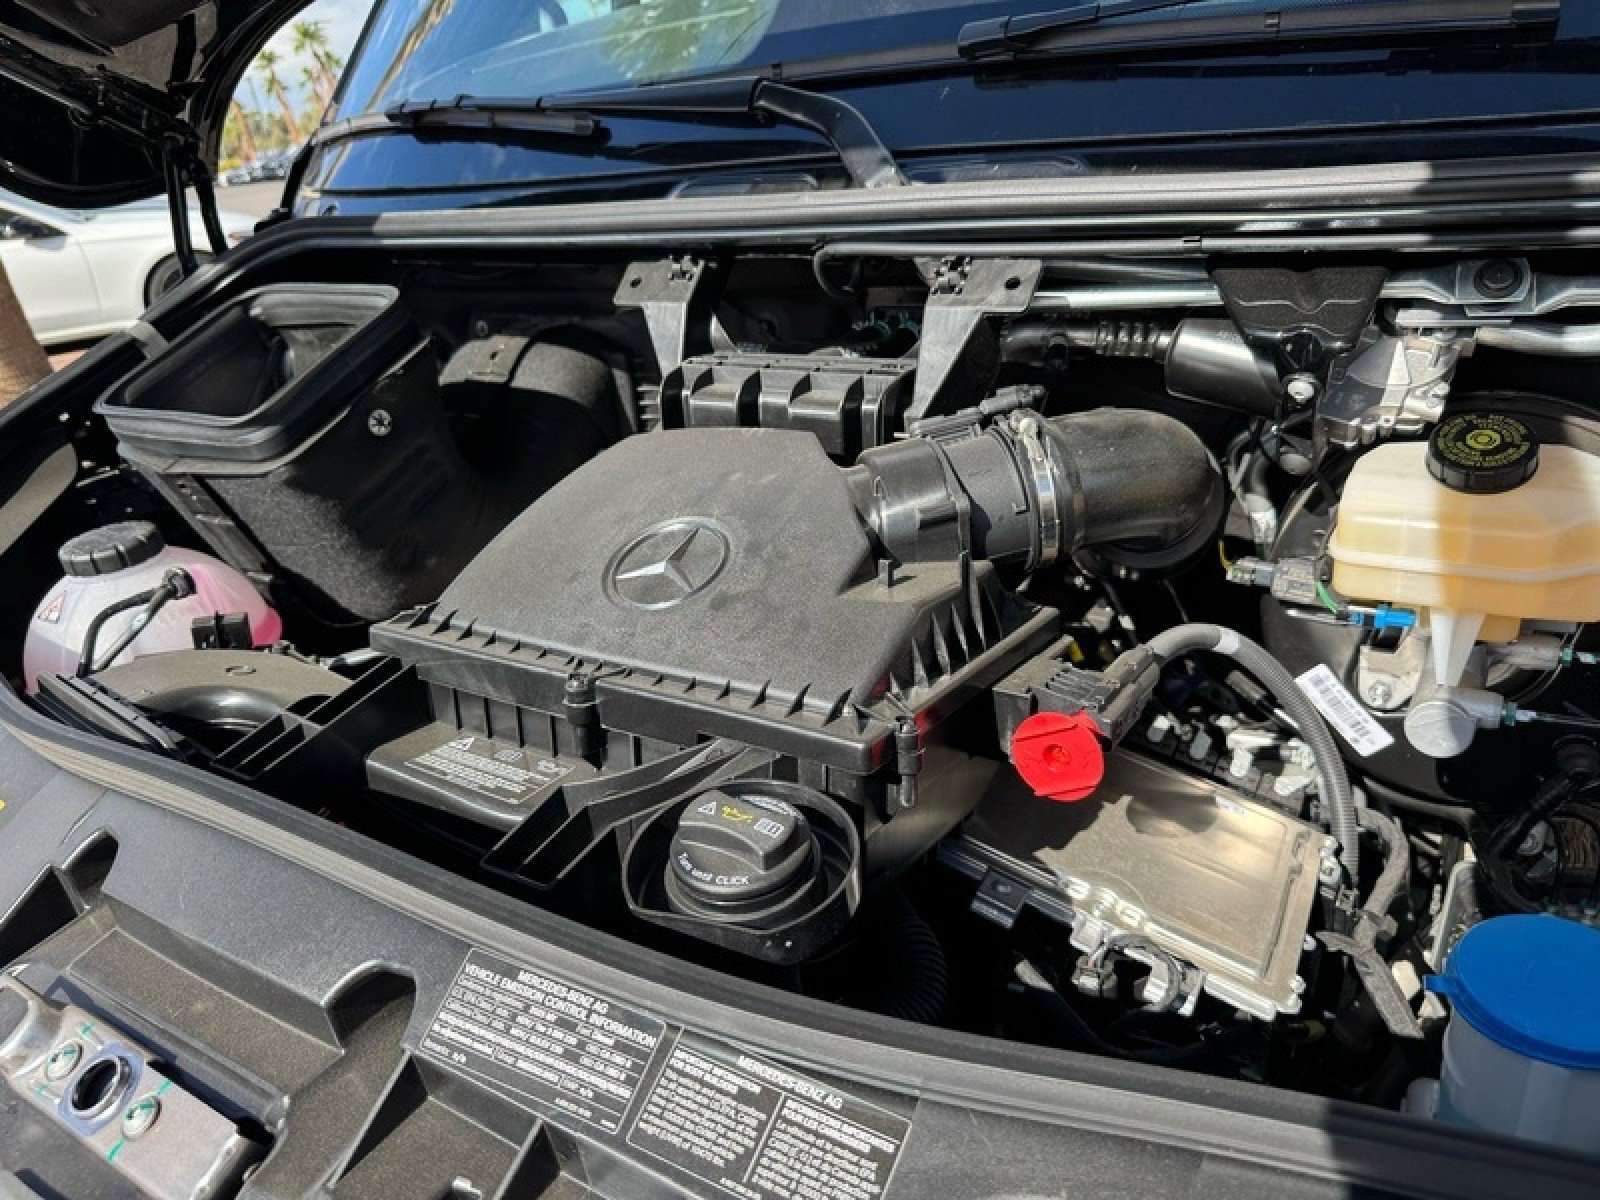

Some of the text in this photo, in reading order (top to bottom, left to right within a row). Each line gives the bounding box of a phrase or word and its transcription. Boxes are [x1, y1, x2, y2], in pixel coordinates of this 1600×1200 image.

[715, 875, 749, 885] CLICK
[465, 962, 657, 1048] VEHICLE EMISSION CONTROL INFORMATION
[592, 1000, 609, 1015] AG
